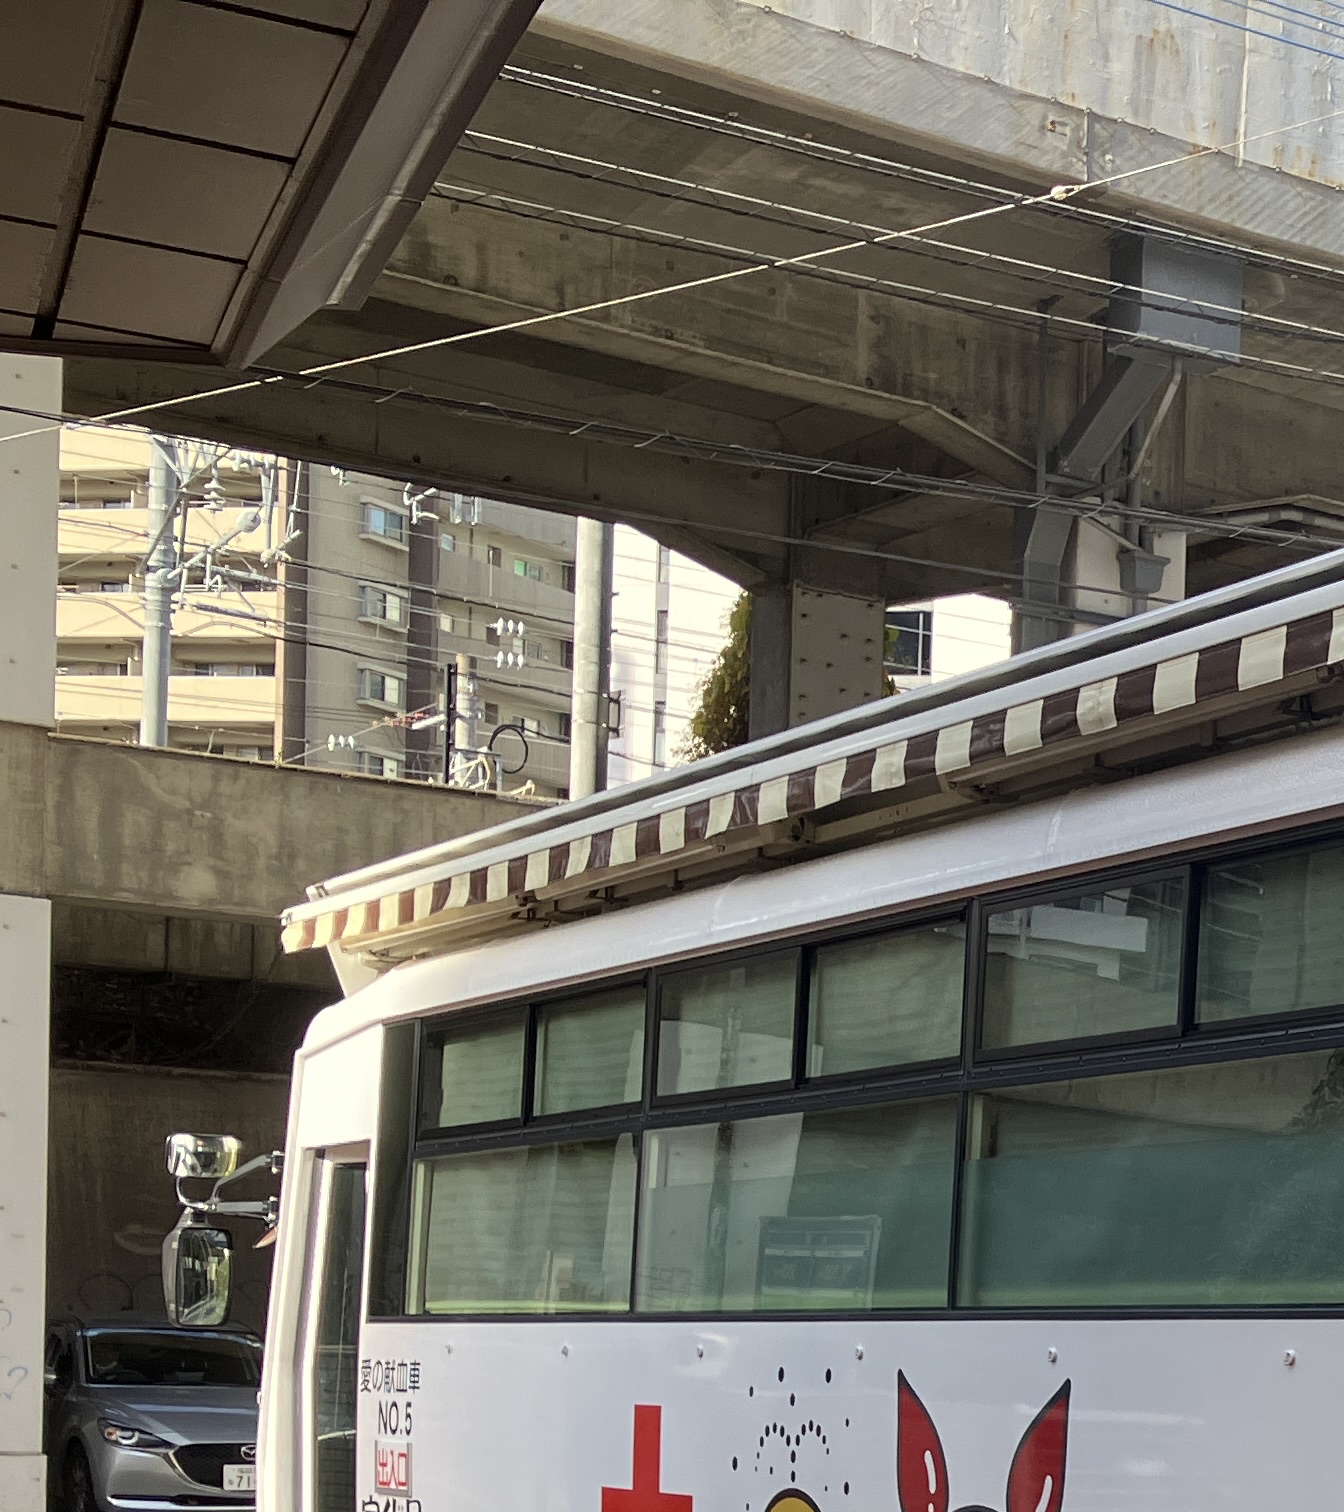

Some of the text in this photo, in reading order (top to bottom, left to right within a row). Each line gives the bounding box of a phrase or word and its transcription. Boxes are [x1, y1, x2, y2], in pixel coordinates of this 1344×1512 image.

[360, 1358, 421, 1395] 愛の献血車
[377, 1400, 413, 1437] NO.5
[377, 1447, 408, 1490] 出入口
